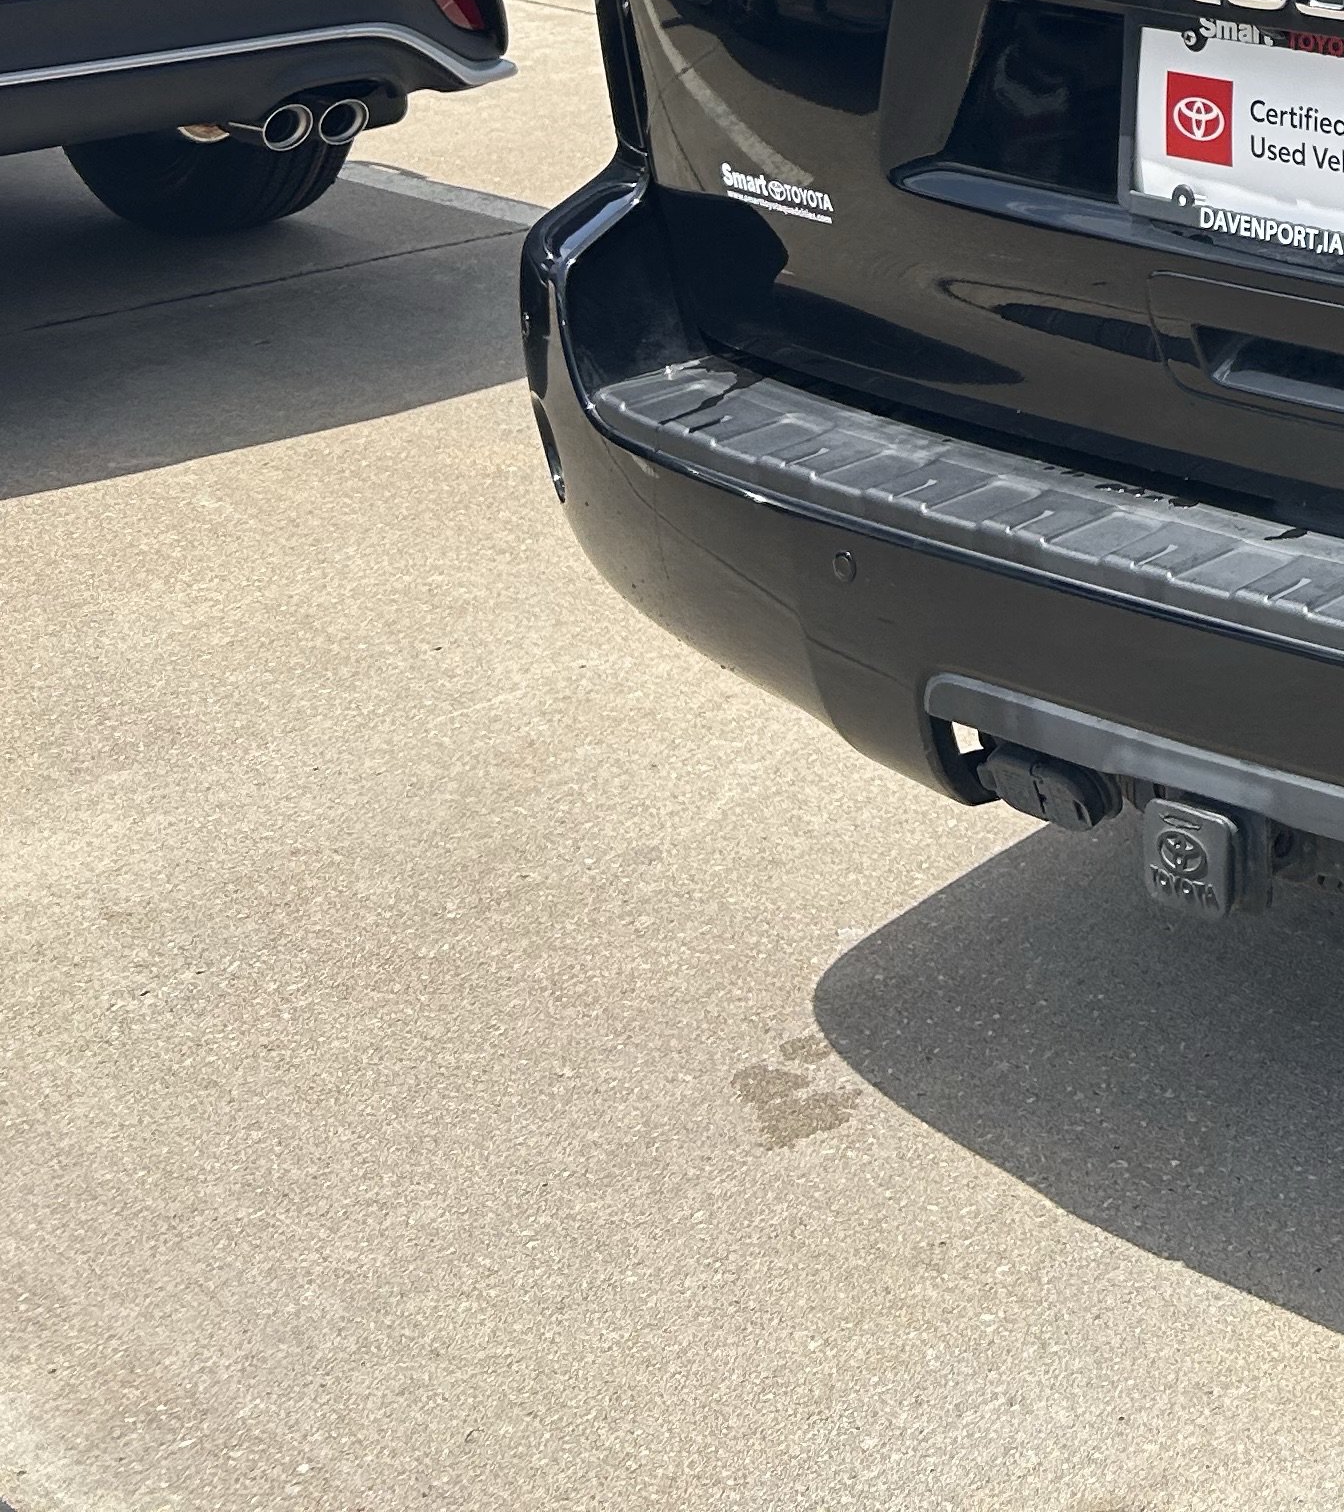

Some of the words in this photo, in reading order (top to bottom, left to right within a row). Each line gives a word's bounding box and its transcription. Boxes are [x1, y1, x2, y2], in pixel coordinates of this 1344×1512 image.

[1250, 134, 1306, 166] Used
[721, 162, 769, 197] Smart
[783, 183, 834, 212] TOYOTA
[1149, 863, 1220, 911] TOYOTA
